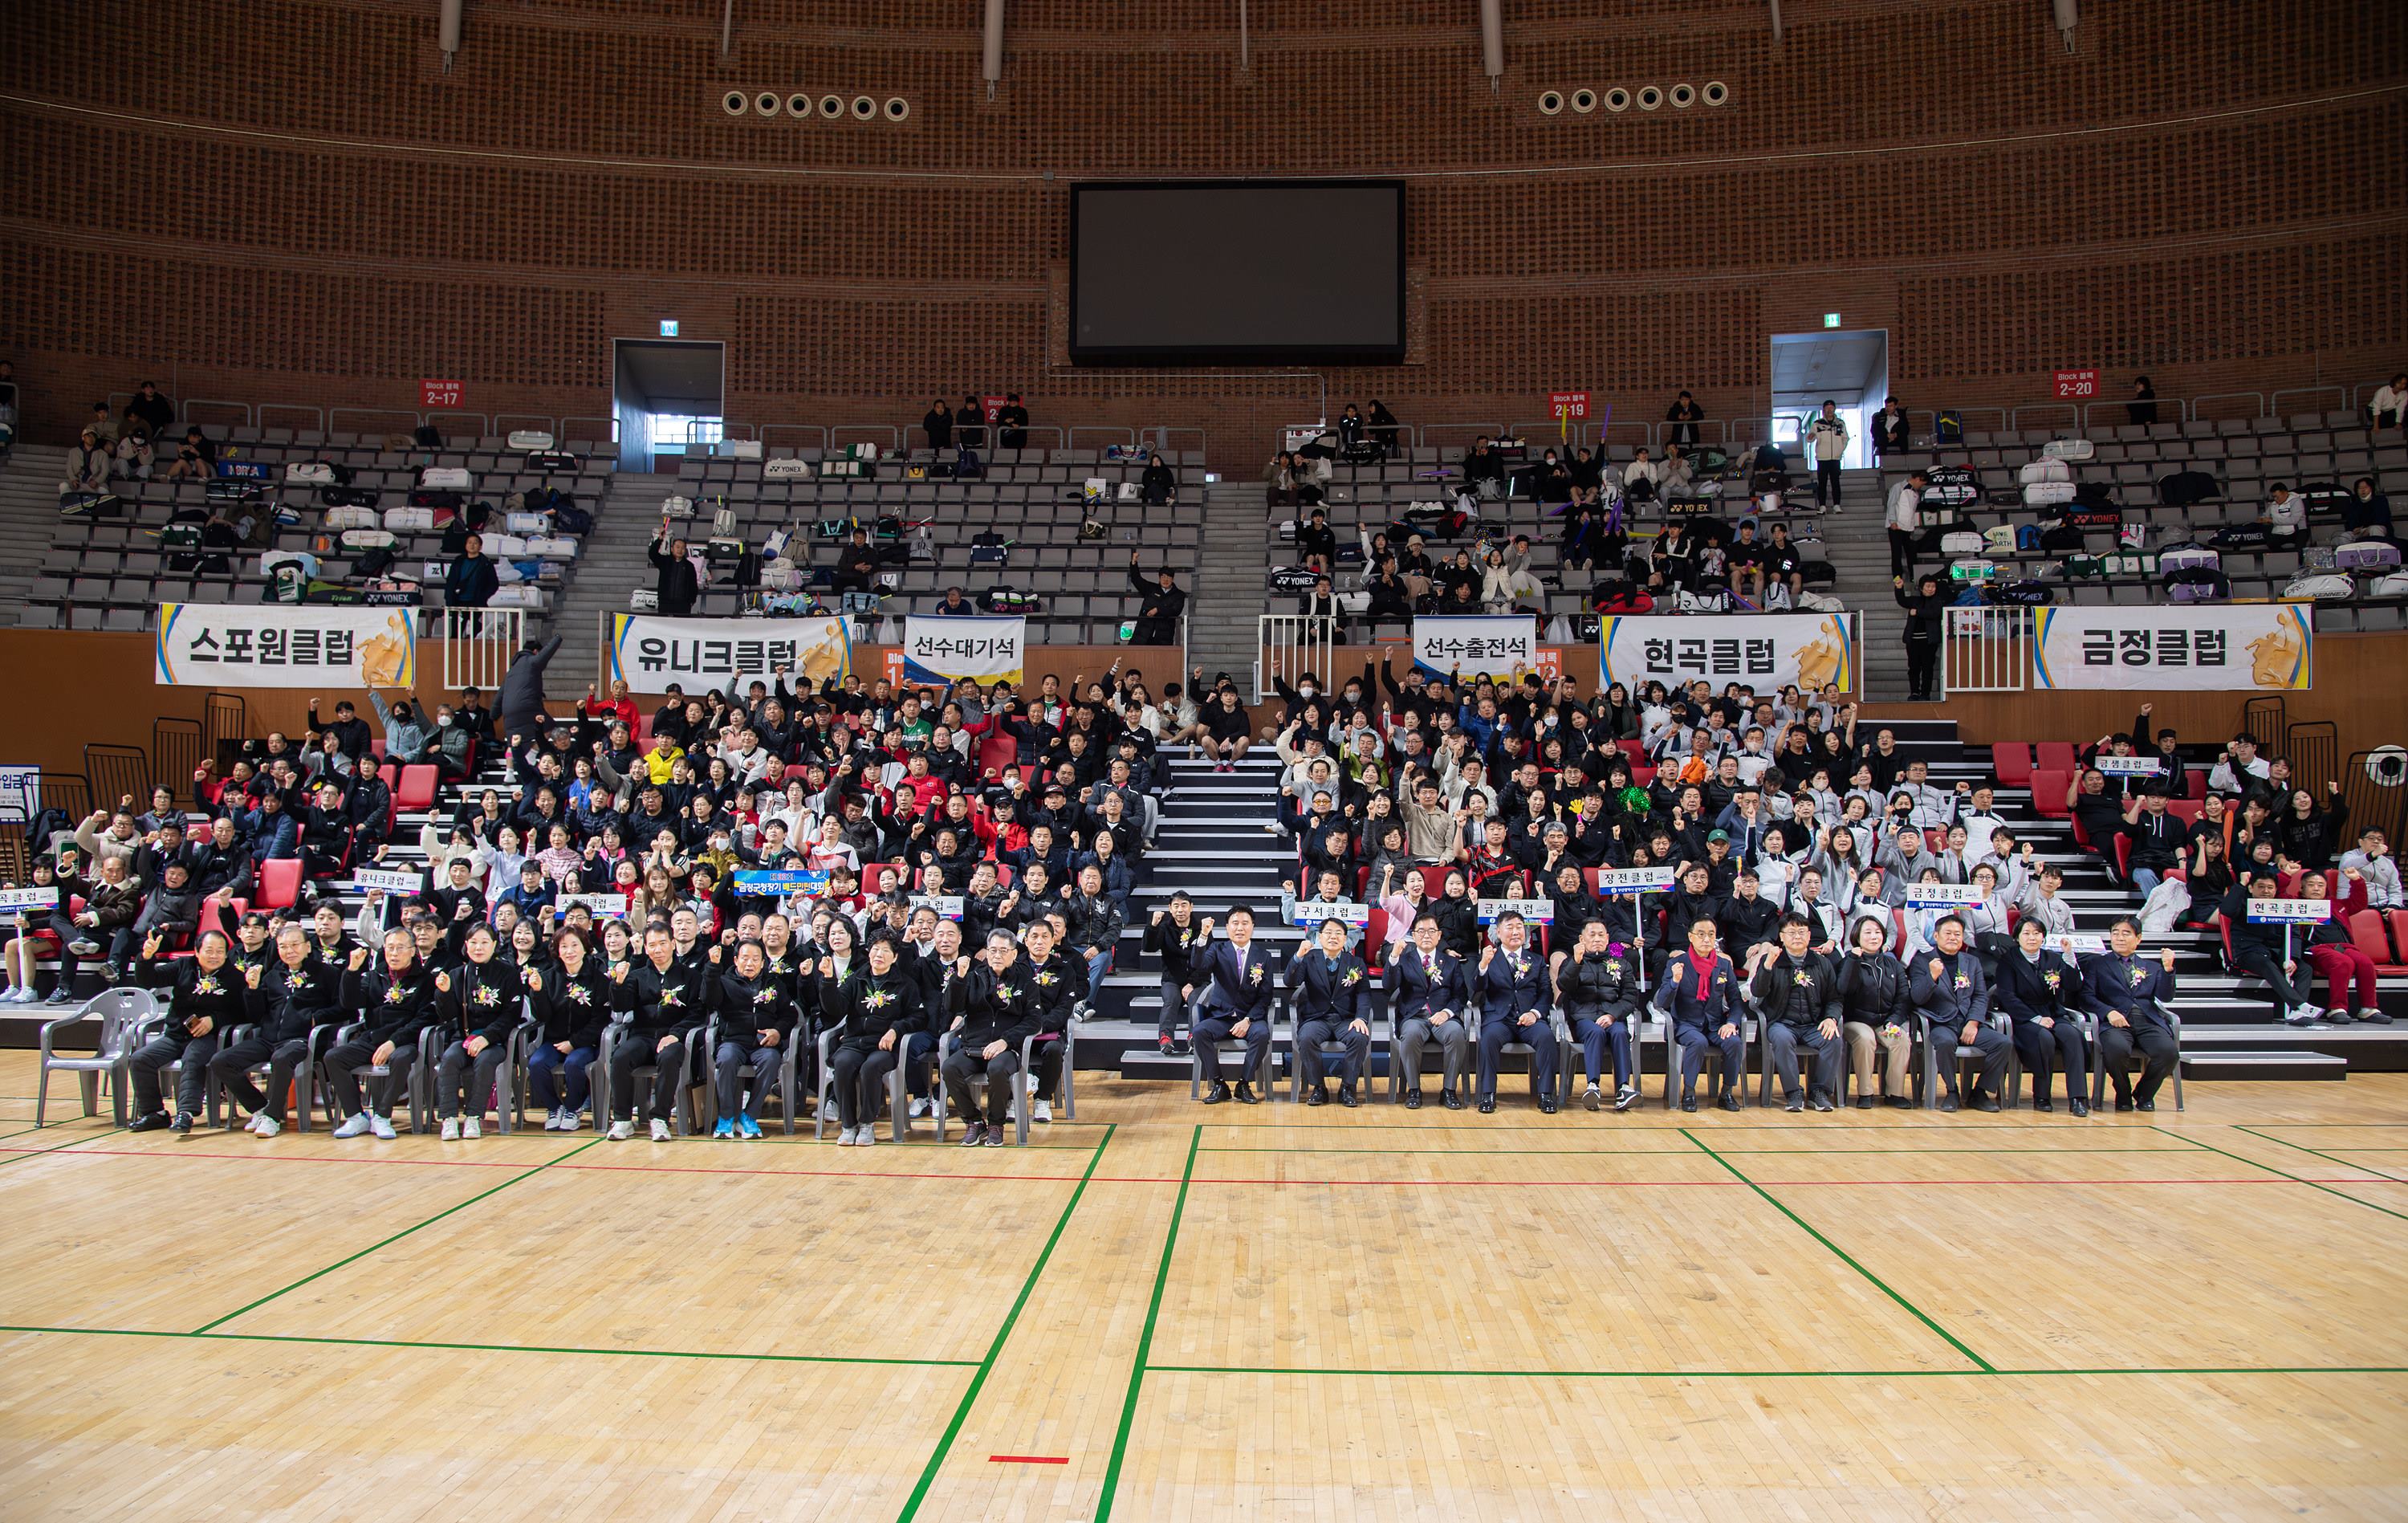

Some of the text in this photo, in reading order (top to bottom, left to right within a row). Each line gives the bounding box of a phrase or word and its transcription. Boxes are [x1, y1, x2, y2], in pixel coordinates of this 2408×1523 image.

[425, 381, 444, 389] Block
[2060, 382, 2092, 396] 2-20
[427, 392, 458, 405] 2-17
[1555, 404, 1584, 416] 2-19
[2092, 514, 2119, 523] YONEX
[382, 594, 409, 603] YONEX
[190, 628, 354, 666] 스포원클럽
[914, 636, 1015, 658] 선수대기석
[1424, 637, 1527, 658] 선수출전석
[2082, 629, 2227, 666] 금정클럽
[638, 637, 796, 674] 유니크클럽
[888, 653, 905, 664] Blo
[1644, 638, 1775, 674] 현곡클럽
[2100, 759, 2142, 769] 금샘클럽
[360, 873, 405, 886] 유니크클럽
[1605, 872, 1653, 884] 장전클럽
[739, 882, 781, 892] 금정구청장기
[1914, 887, 1962, 899] 금정클럽
[1301, 906, 1348, 918] 구서클럽
[2255, 903, 2308, 914] 현곡클럽
